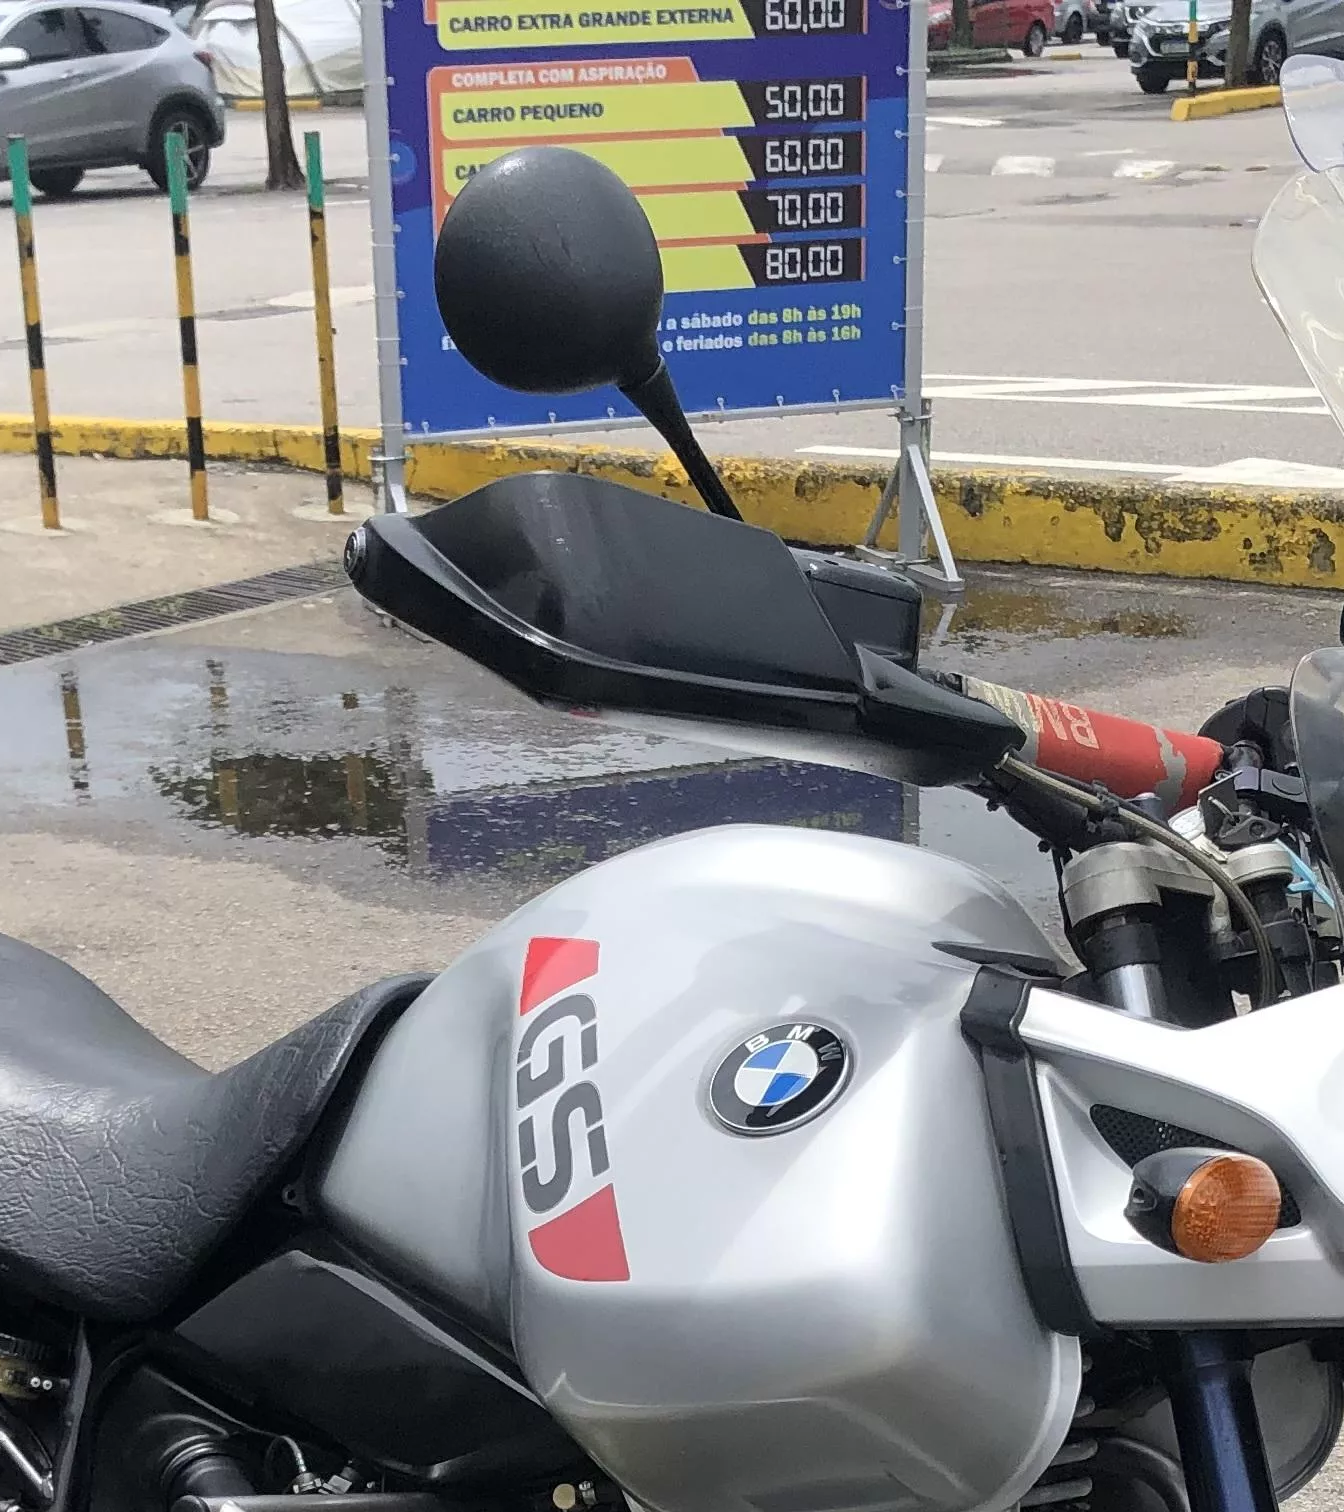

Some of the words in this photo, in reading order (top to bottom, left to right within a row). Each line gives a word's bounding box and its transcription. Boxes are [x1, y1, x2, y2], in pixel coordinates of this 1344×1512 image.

[449, 16, 512, 33] CARRO
[517, 14, 574, 30] EXTRA
[579, 10, 652, 28] GRANDE
[656, 8, 734, 25] EXTERNA
[765, 0, 845, 33] 60,00
[452, 70, 536, 88] COMPLETA
[539, 68, 574, 84] COM
[578, 62, 667, 83] ASPIRAÇÃO
[453, 106, 515, 124] CARRO
[520, 102, 604, 122] PEQUENO
[765, 84, 844, 121] 50,00
[765, 138, 844, 175] 60,00
[766, 192, 844, 228] 70,00
[766, 245, 844, 282] 80,00
[681, 312, 743, 329] sábado
[748, 309, 778, 325] das
[782, 308, 803, 323] 8h
[807, 305, 827, 321] às
[831, 303, 862, 320] 19h
[676, 334, 743, 351] feriados
[748, 330, 778, 346] das
[782, 329, 803, 344] 8h
[807, 326, 827, 342] às
[831, 325, 862, 341] 16h
[744, 1024, 842, 1062] BMW
[516, 992, 611, 1215] GS
